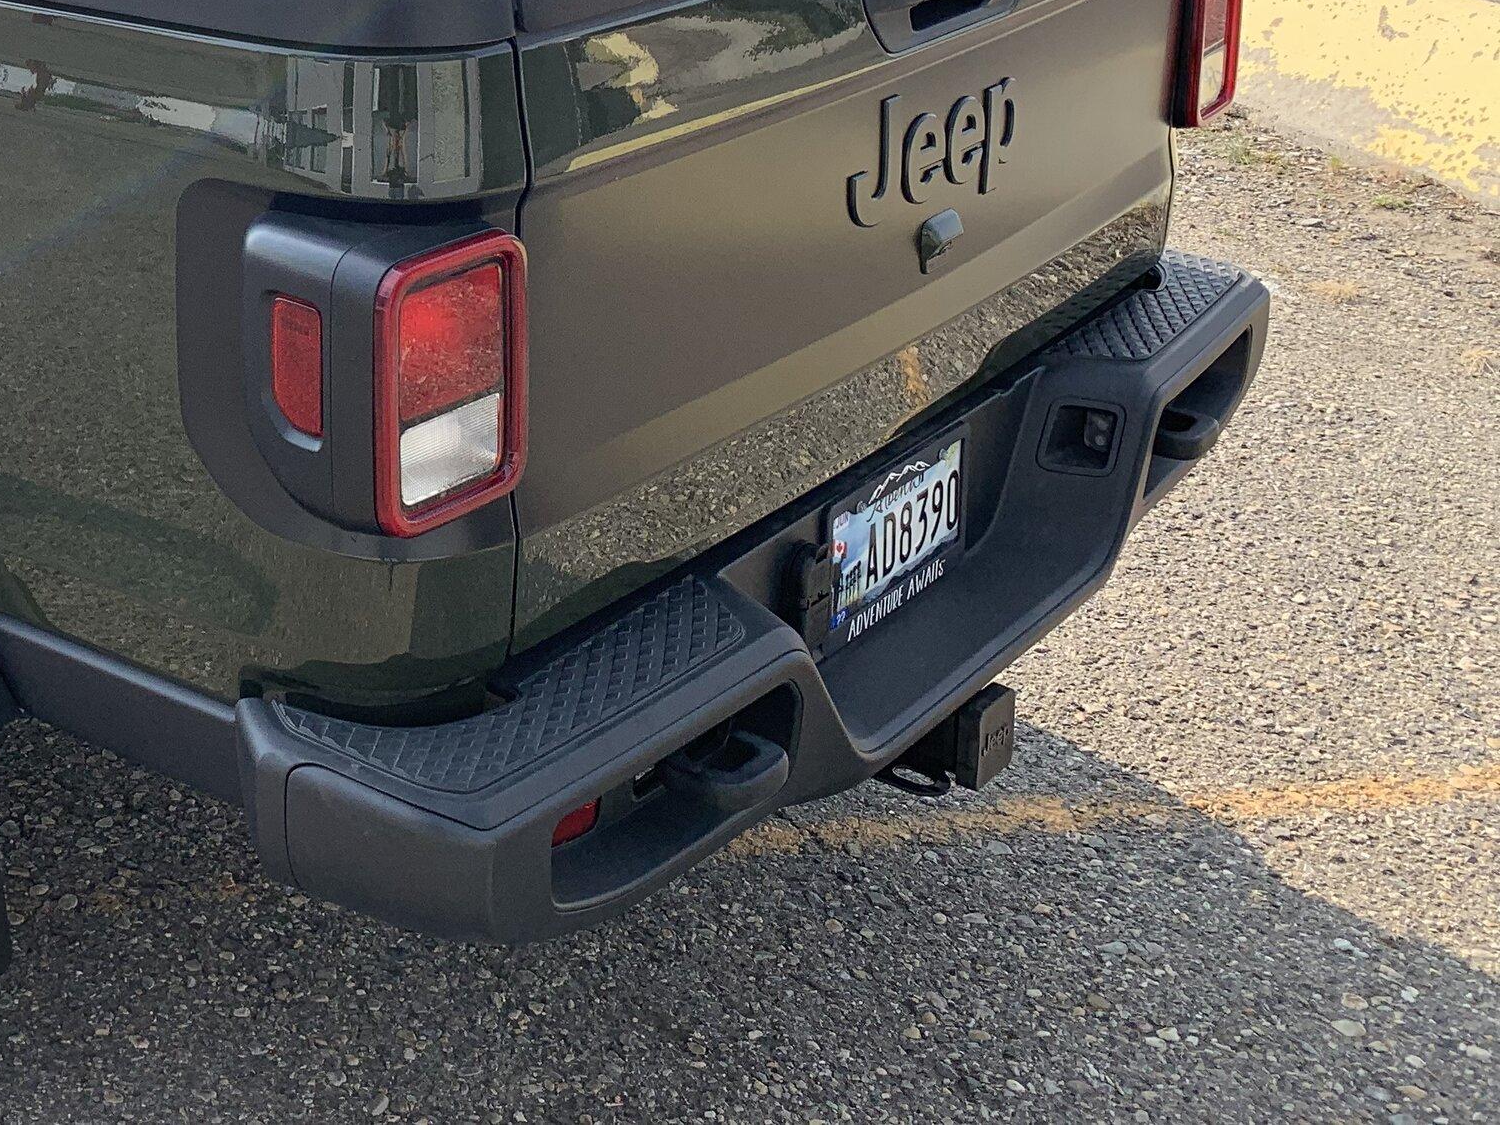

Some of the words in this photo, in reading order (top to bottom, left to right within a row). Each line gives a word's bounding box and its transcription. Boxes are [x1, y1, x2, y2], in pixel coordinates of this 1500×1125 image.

[846, 75, 1016, 228] Jeep
[865, 469, 960, 590] AD8390
[847, 586, 904, 642] ADVENTURE
[906, 558, 946, 601] AWAITS
[981, 725, 1011, 757] Jeep
